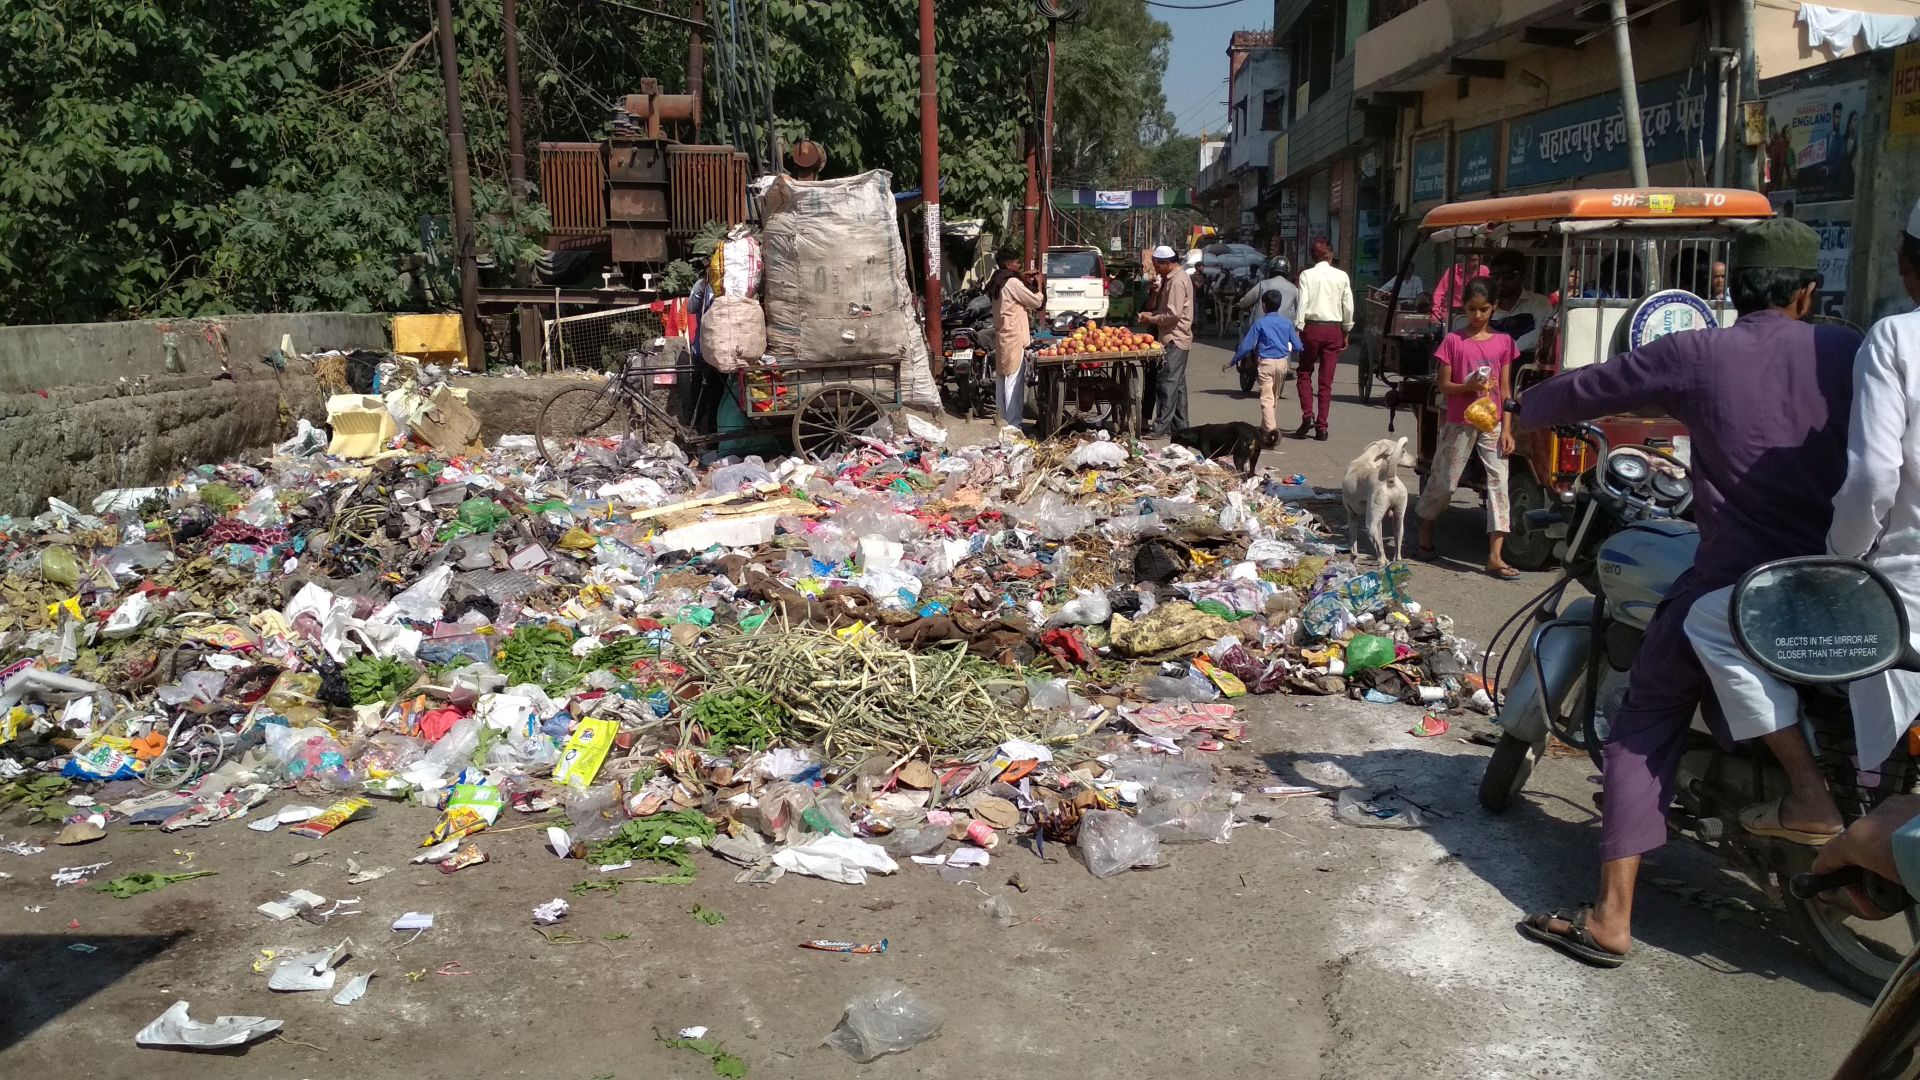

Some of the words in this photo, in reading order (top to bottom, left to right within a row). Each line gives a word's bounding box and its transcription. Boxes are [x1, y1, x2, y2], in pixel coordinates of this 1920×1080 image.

[1792, 112, 1832, 127] ENGLAND
[1539, 119, 1602, 163] सहारनपुर
[1775, 636, 1808, 647] OBJECTS
[1809, 636, 1817, 646] IN
[1819, 636, 1833, 646] THE
[1834, 635, 1863, 645] MIRROR
[1864, 634, 1878, 644] ARE
[1777, 649, 1807, 660] CLOSER
[1809, 649, 1828, 659] THAN
[1829, 648, 1847, 658] THEY
[1848, 647, 1877, 657] APPEAR
